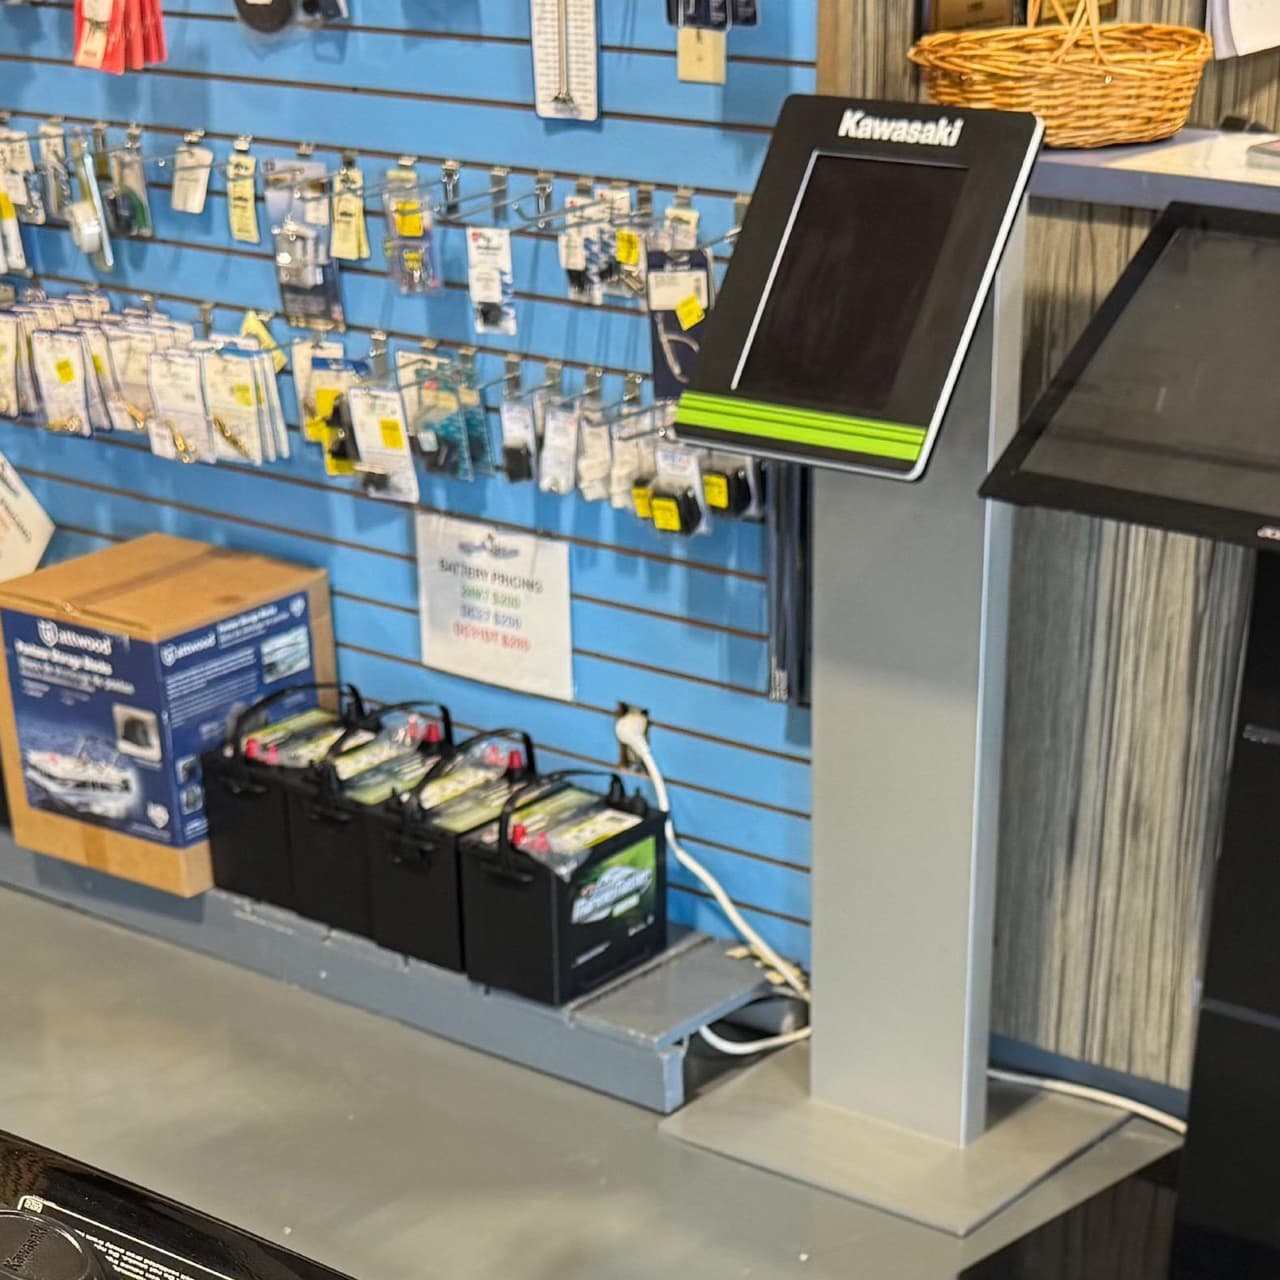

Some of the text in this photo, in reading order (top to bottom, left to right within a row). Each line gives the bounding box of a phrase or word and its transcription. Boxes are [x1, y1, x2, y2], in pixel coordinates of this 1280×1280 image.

[838, 108, 964, 147] Kawasaki
[439, 559, 544, 594] BATTERY PRICING
[58, 629, 112, 656] attwood
[176, 629, 217, 660] attwood
[3, 1223, 48, 1271] Kawasaki
[104, 1241, 125, 1254] away
[108, 1249, 120, 1259] Do
[125, 1250, 143, 1261] area
[143, 1258, 180, 1277] ventilated
[149, 1266, 162, 1275] not
[145, 1272, 160, 1280] can
[163, 1272, 176, 1280] Do
